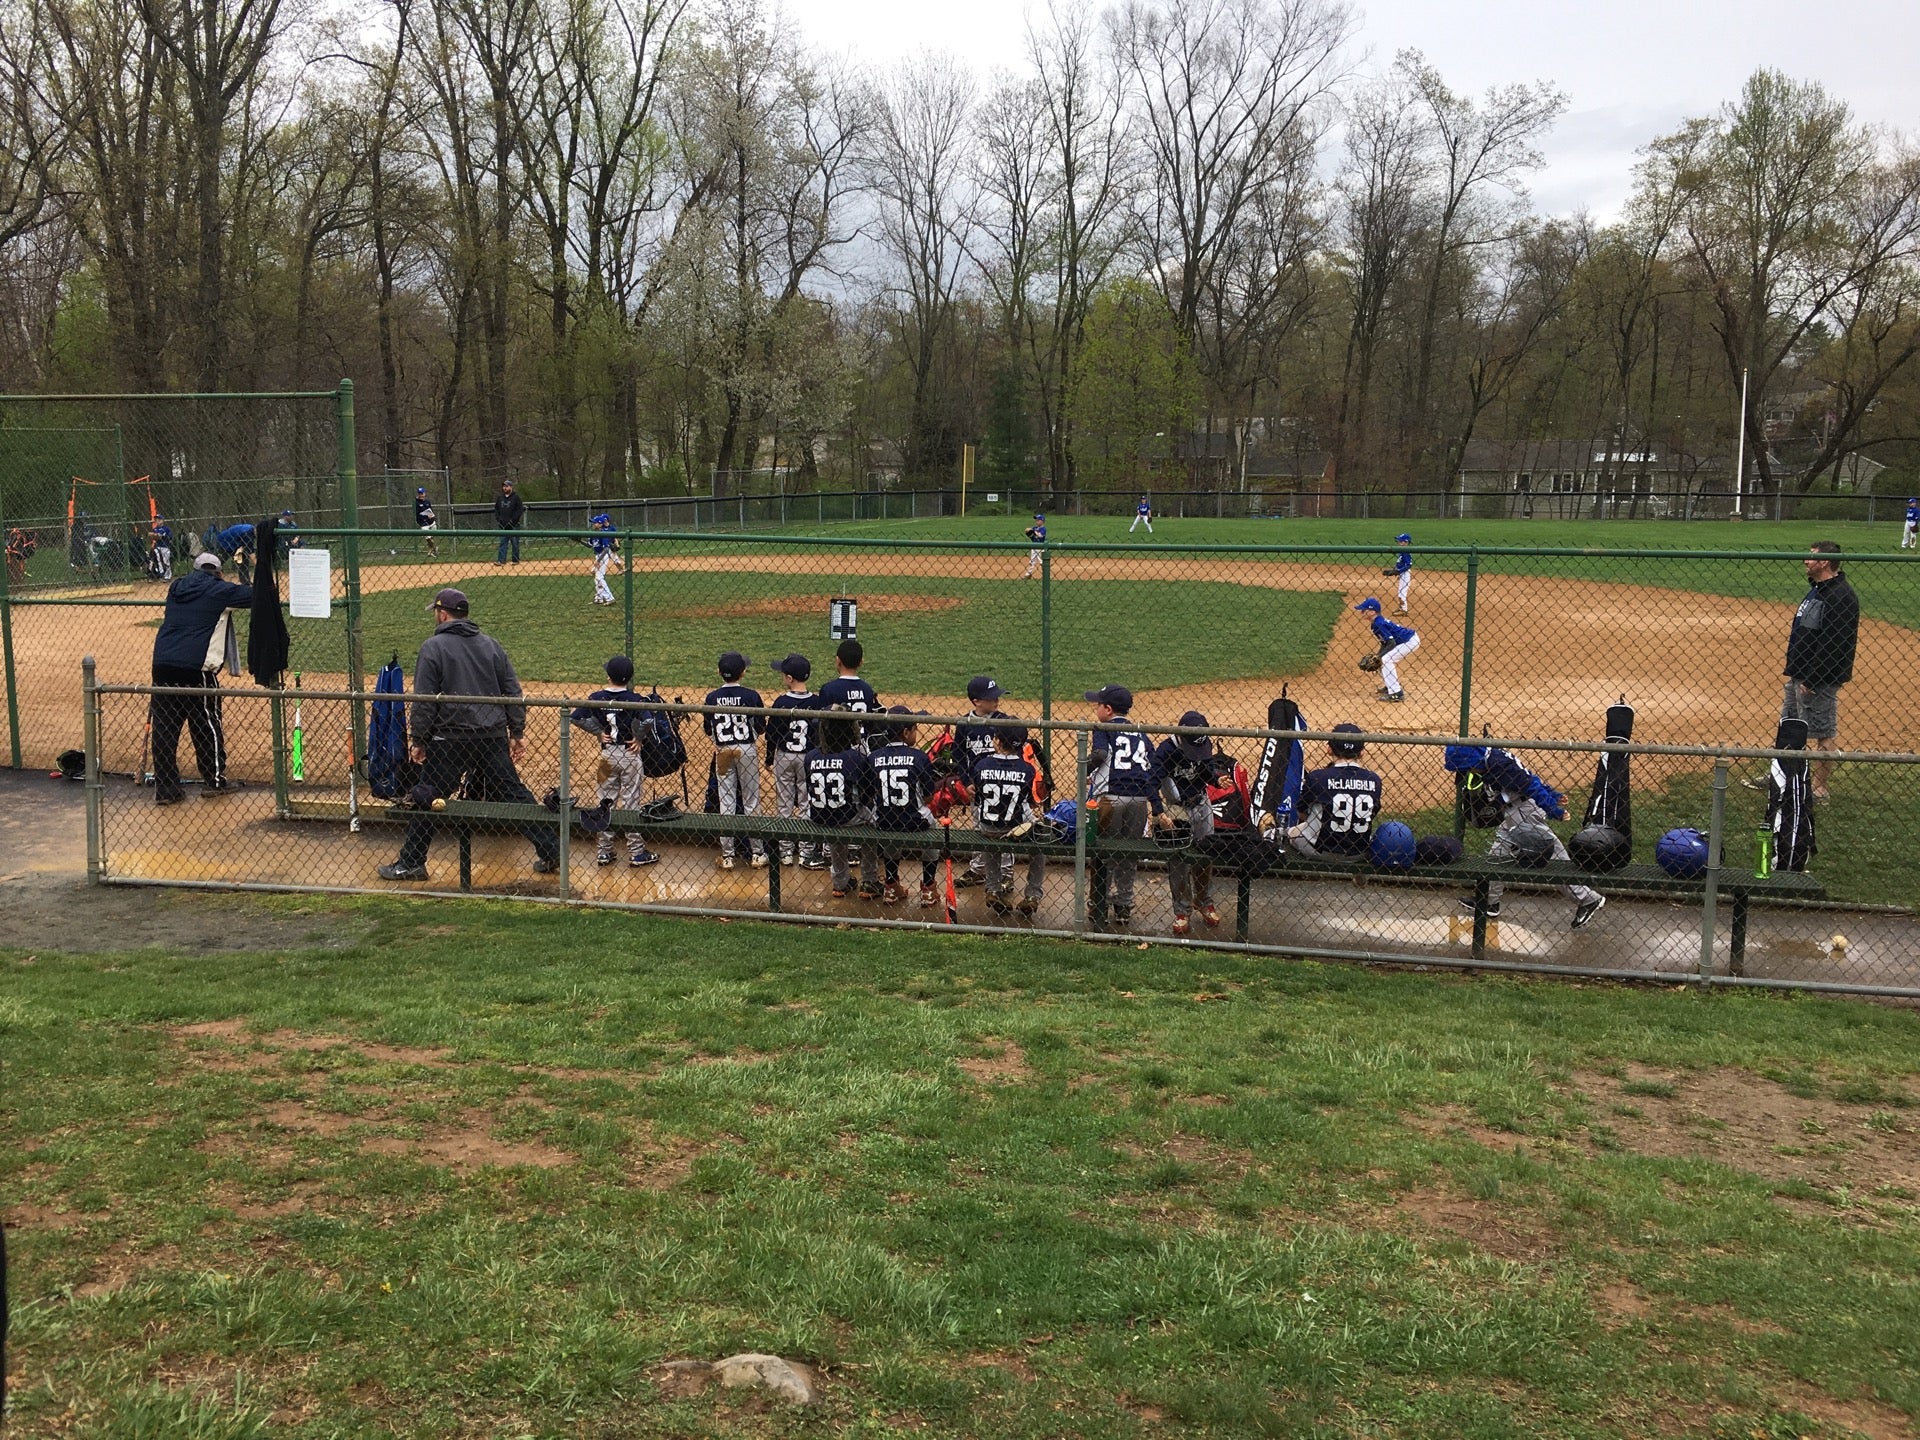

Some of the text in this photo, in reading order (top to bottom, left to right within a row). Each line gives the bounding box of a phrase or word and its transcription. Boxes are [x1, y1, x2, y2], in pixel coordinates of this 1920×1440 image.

[717, 696, 742, 706] KOHUT
[847, 690, 865, 700] LORA
[606, 712, 619, 742] 1
[713, 713, 750, 743] 28
[785, 719, 809, 752] 3
[810, 758, 844, 770] ROLLER
[874, 756, 915, 768] DELACRUZ
[1114, 735, 1152, 772] 24
[810, 772, 847, 809] 33
[879, 768, 910, 807] 15
[980, 769, 1027, 783] HERNANDEZ
[1327, 778, 1376, 792] McLAUGHLIN
[982, 783, 1022, 822] 27
[1329, 793, 1374, 834] 99
